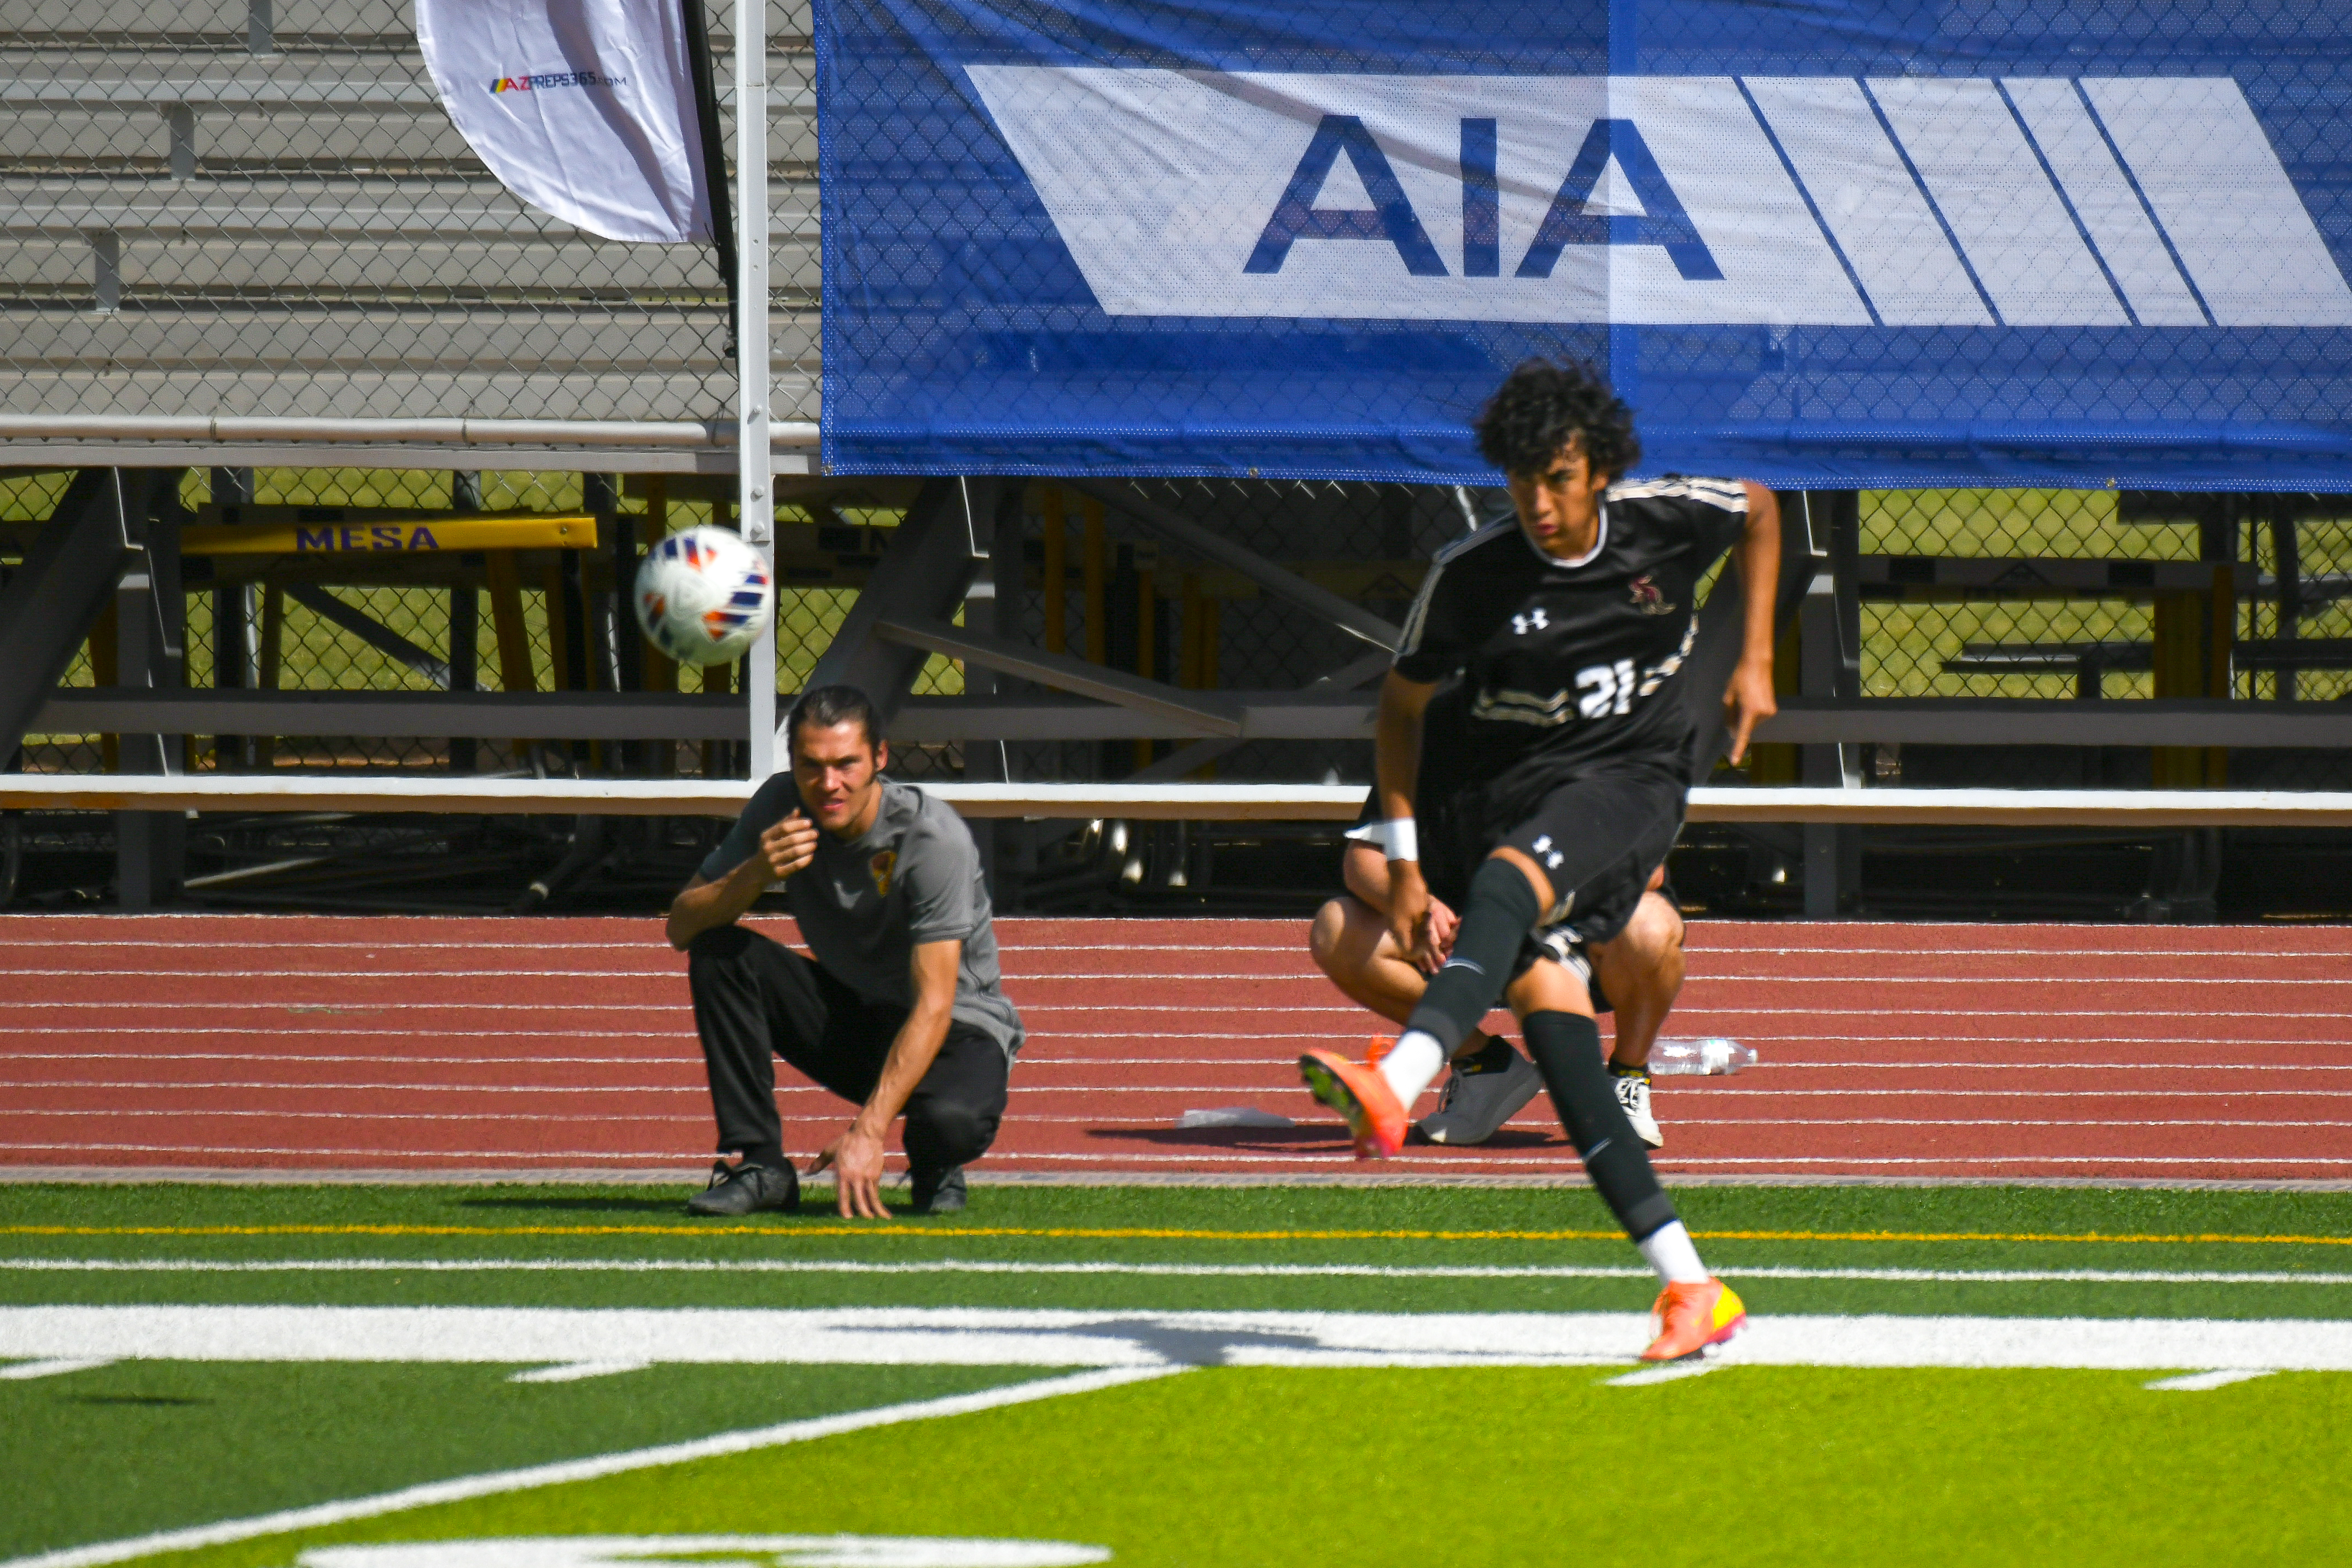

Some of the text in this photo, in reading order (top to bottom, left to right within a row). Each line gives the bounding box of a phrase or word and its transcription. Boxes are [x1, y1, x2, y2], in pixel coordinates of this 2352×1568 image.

[1242, 114, 1726, 281] AIA
[296, 525, 439, 551] MESA
[1575, 657, 1636, 719] 21
